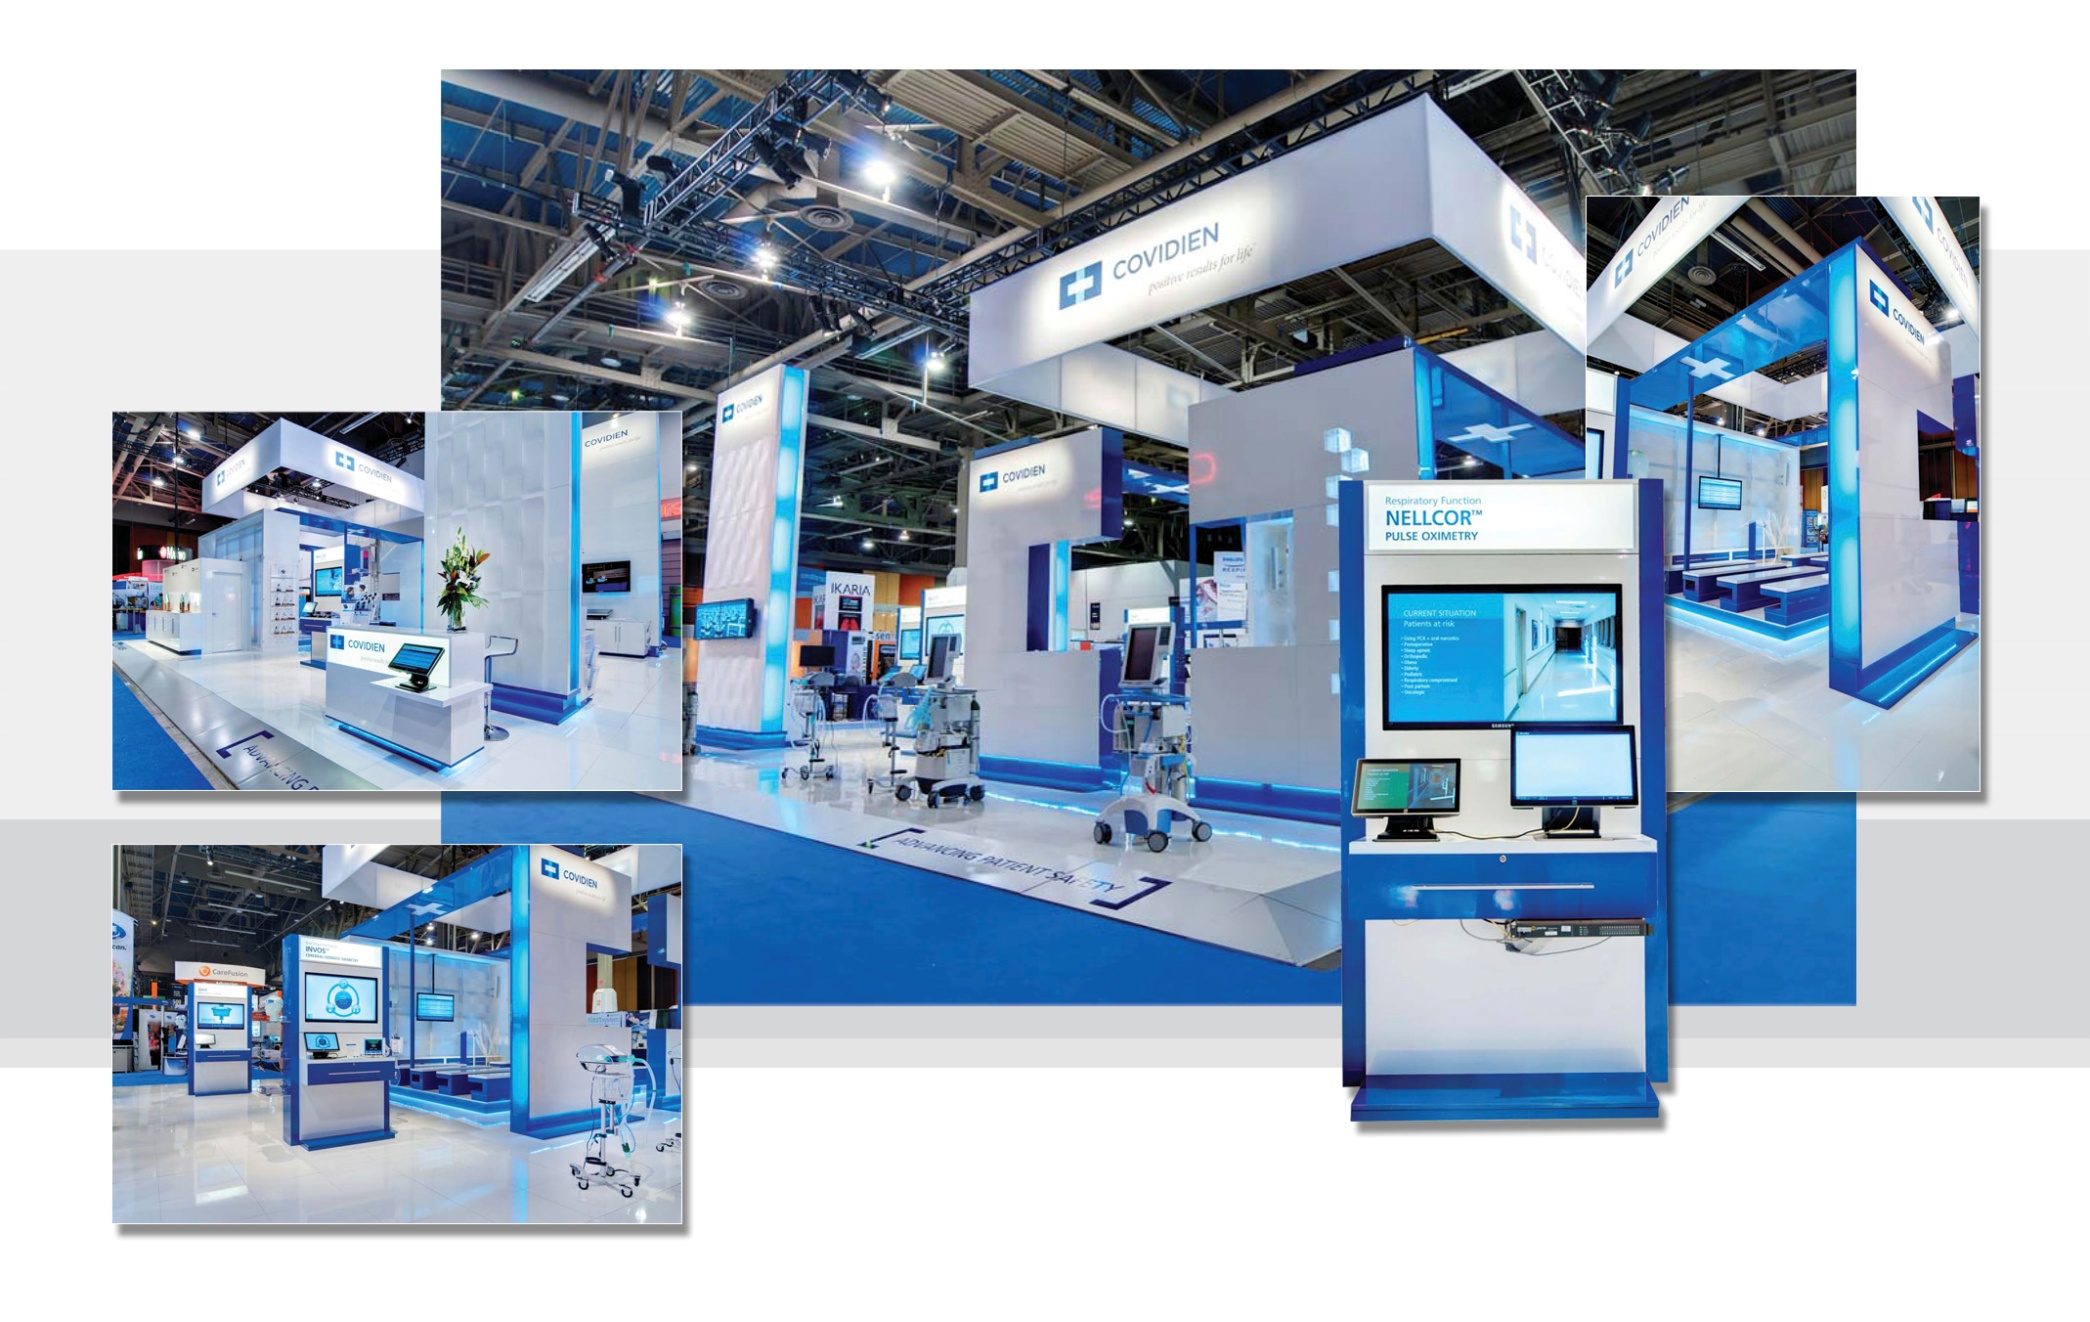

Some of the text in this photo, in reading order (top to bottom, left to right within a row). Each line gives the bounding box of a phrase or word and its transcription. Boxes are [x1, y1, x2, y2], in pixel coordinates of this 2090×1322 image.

[1638, 196, 1690, 257] COVIDIEN
[1113, 222, 1219, 280] COVIDIEN
[1148, 272, 1185, 296] positive
[1186, 257, 1218, 279] results
[1218, 254, 1234, 272] for
[1893, 308, 1925, 346] COVIDIEN
[584, 429, 628, 448] COVIDIEN
[358, 463, 392, 483] COVIDIEN
[1002, 464, 1046, 483] COVIDIEN
[1385, 496, 1482, 507] Respiratory Function
[1385, 531, 1479, 541] PULSE OXIMETRY
[831, 582, 871, 597] IKARIA
[1403, 609, 1477, 617] CURRENT SITUATION
[348, 639, 385, 653] COVIDIEN
[893, 838, 983, 861] ADVANCING
[978, 855, 1051, 875] PATIENT
[563, 870, 598, 889] COVIDIEN
[212, 968, 249, 978] CareFusion
